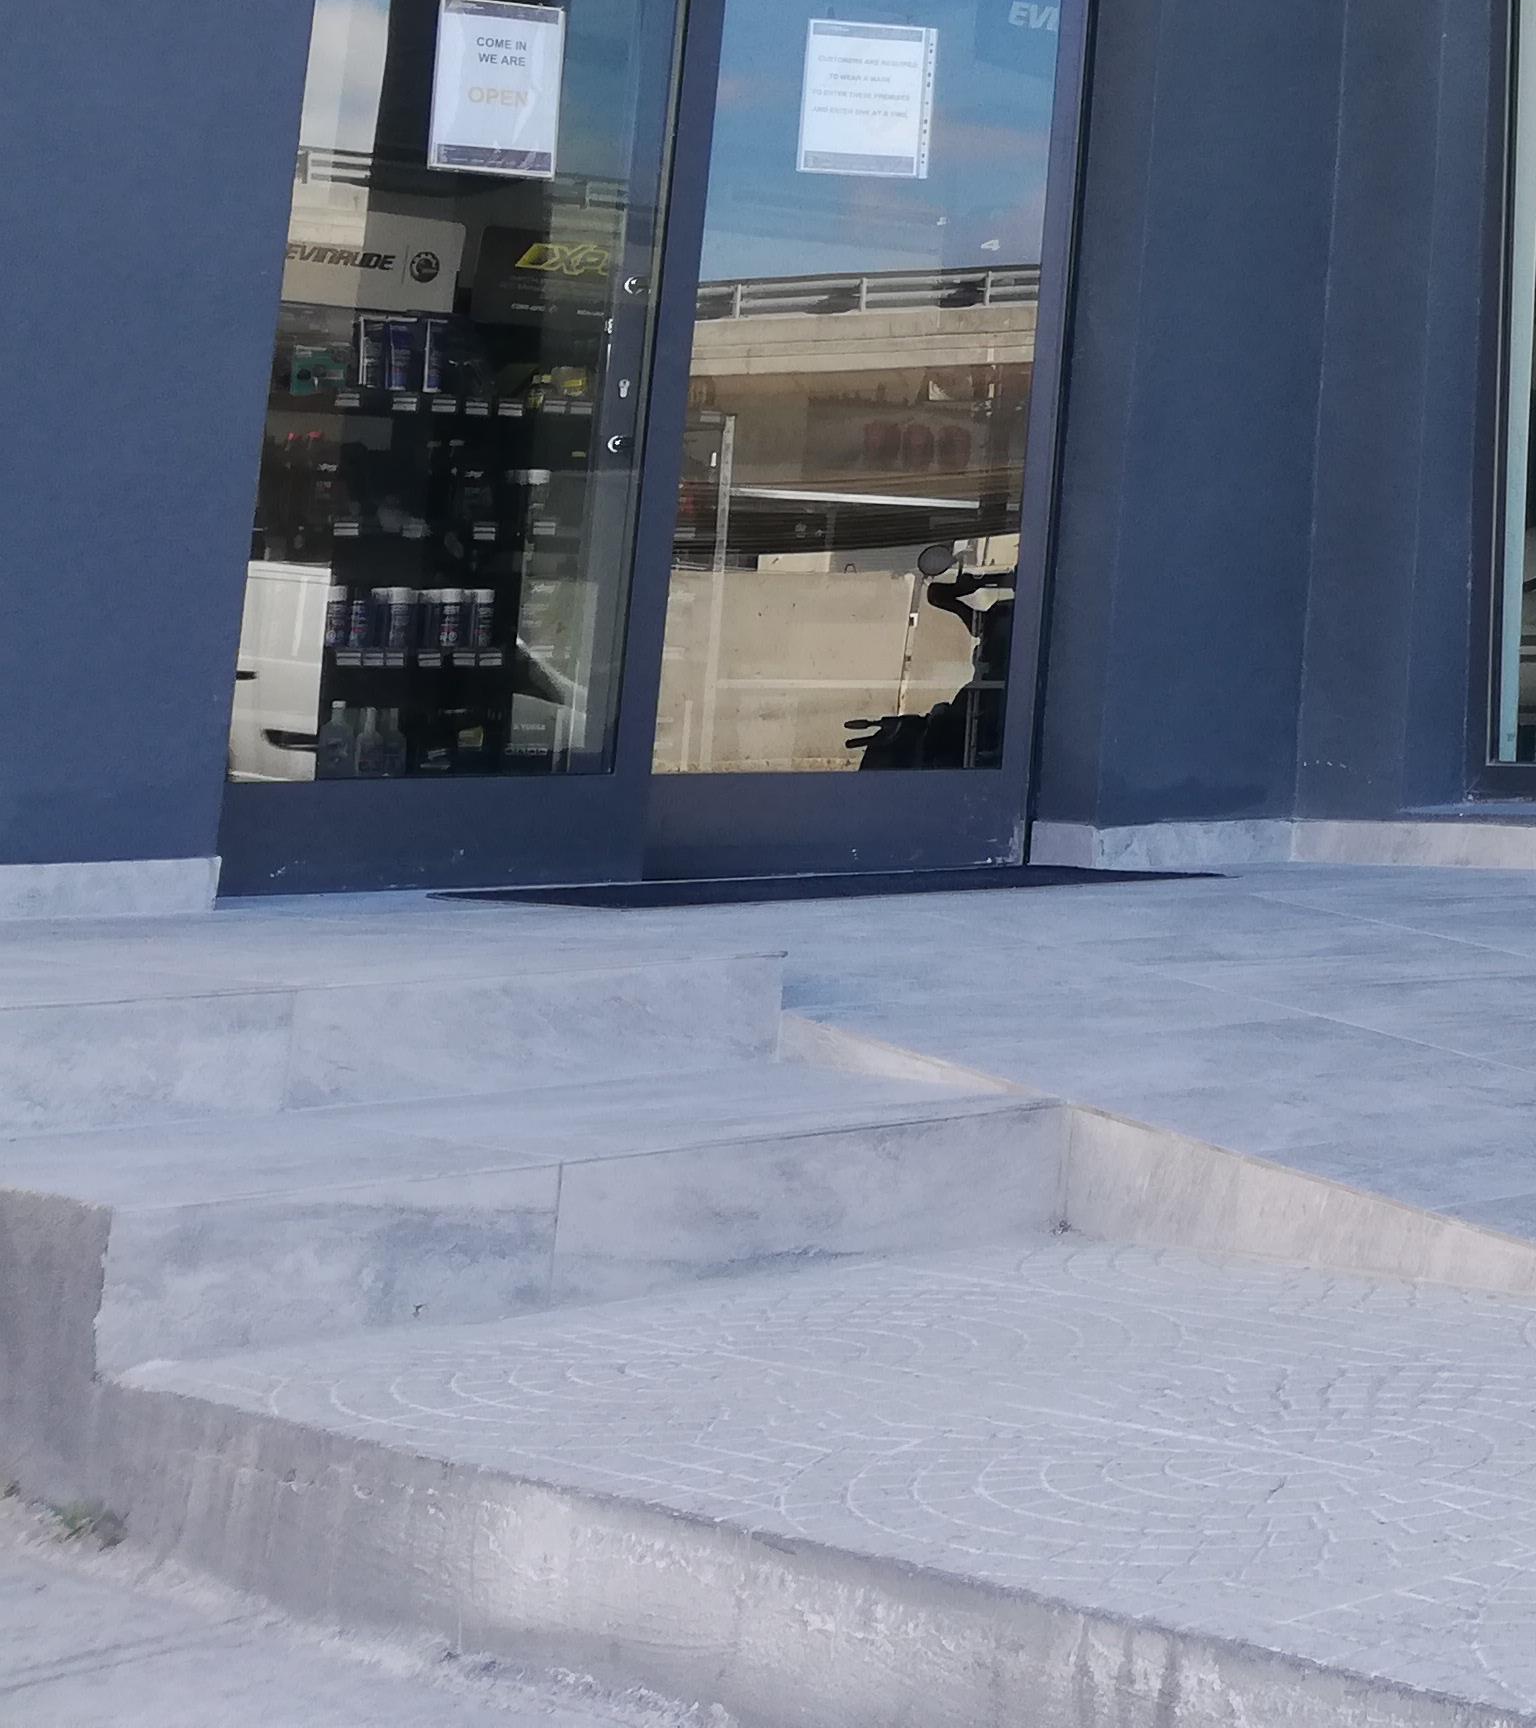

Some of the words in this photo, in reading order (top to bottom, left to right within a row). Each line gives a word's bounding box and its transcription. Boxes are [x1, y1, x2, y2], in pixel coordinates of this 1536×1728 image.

[476, 36, 511, 50] COME
[515, 40, 528, 51] IN
[478, 52, 497, 64] WE
[501, 55, 526, 67] ARE
[467, 86, 529, 107] OPEN
[286, 242, 396, 271] EVINRUDE
